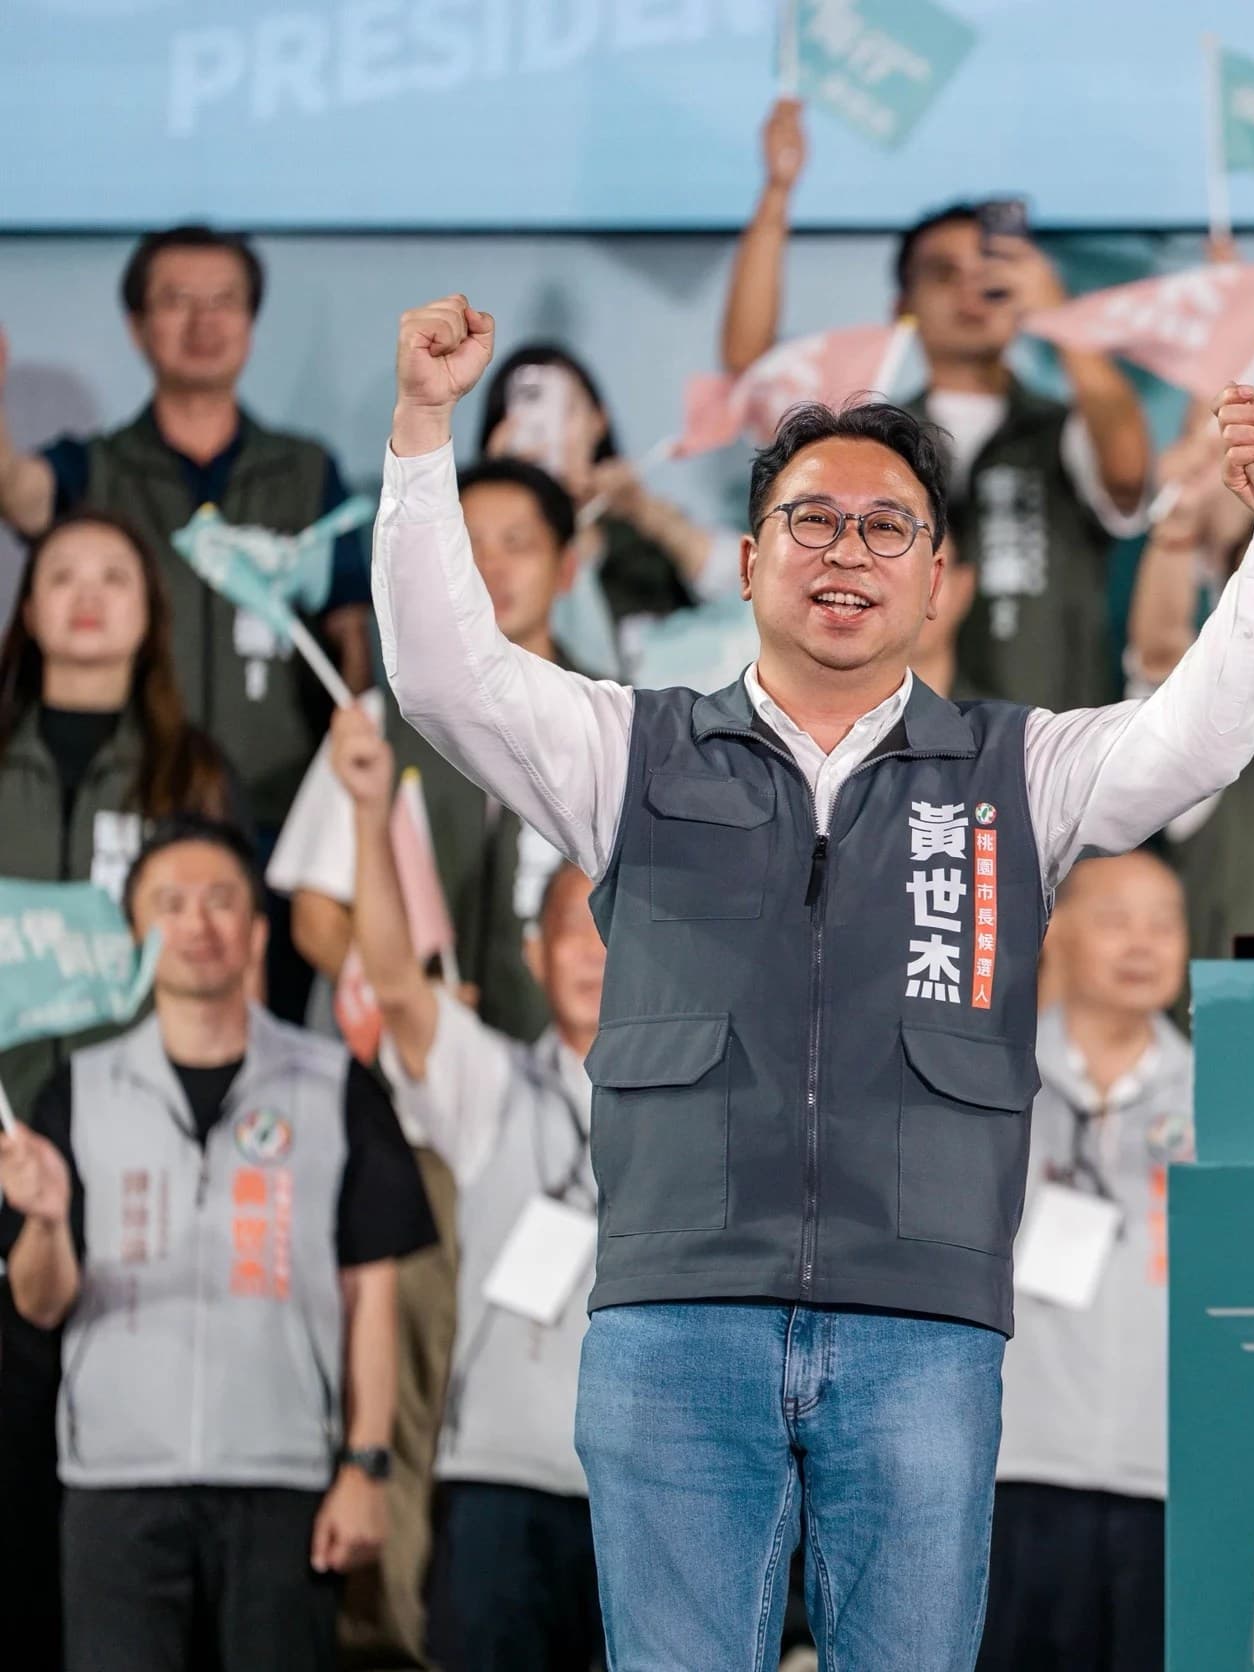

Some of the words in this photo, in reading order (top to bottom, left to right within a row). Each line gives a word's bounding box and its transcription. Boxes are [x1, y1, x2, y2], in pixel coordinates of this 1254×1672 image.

[906, 801, 969, 1003] 黃世杰
[974, 833, 995, 1005] 桃園市長候選人
